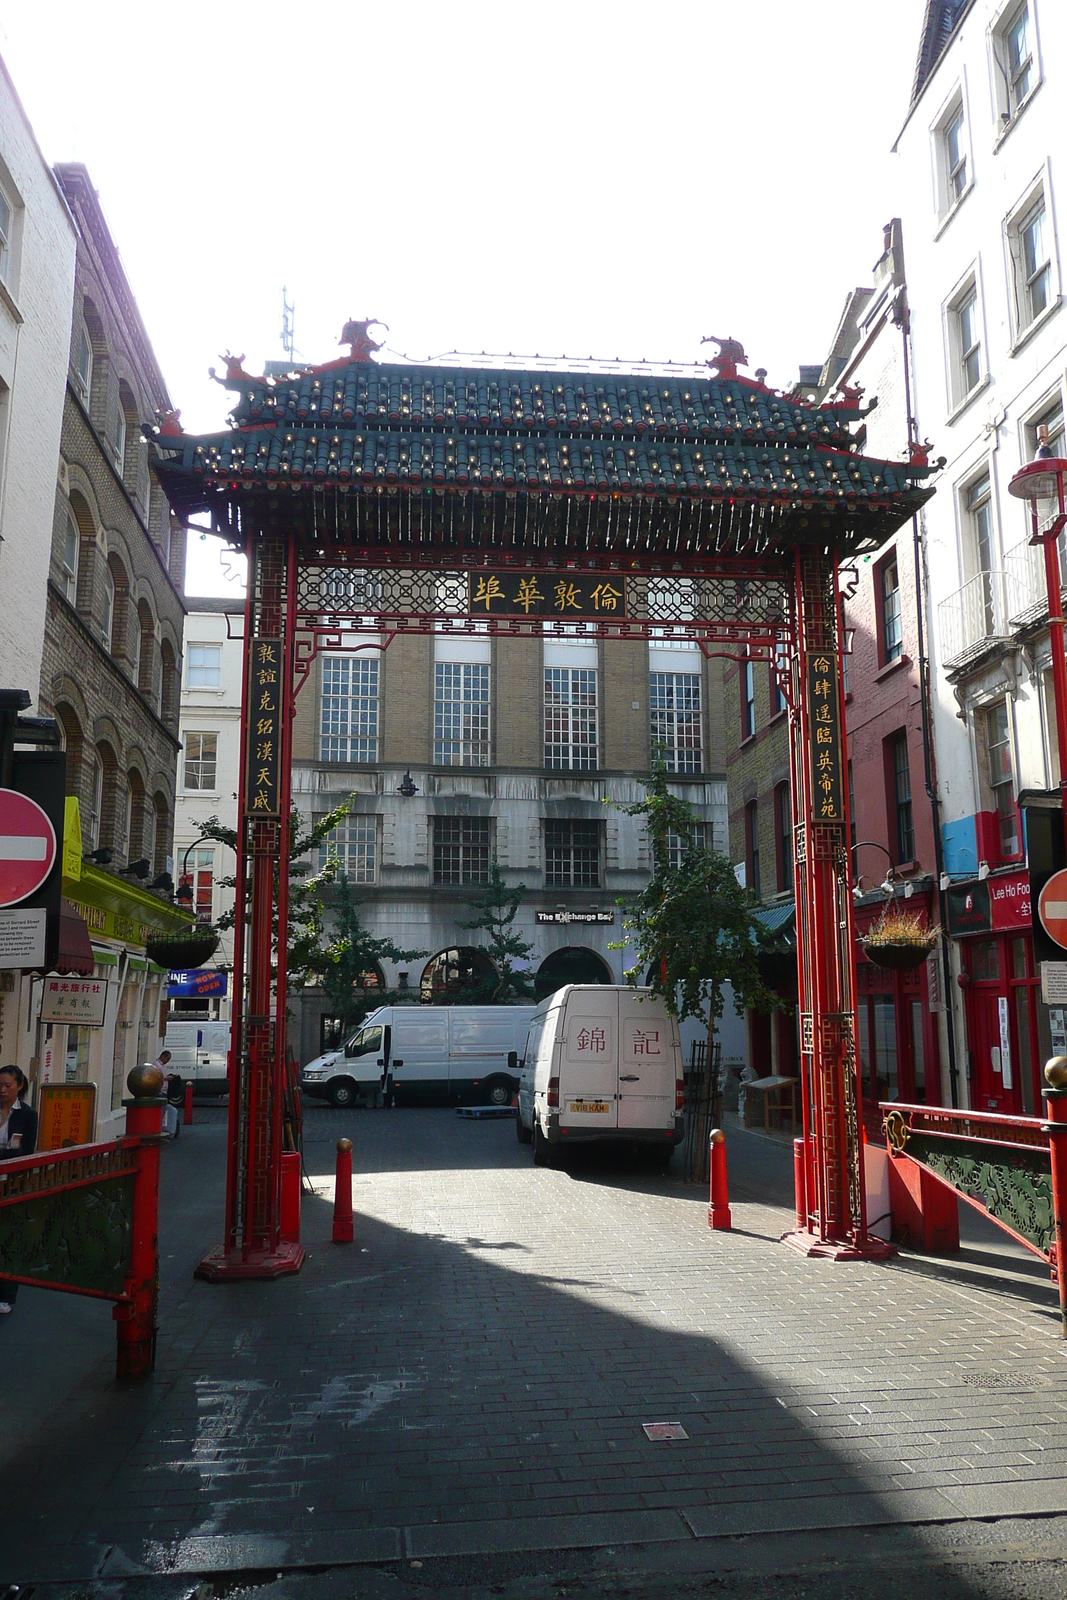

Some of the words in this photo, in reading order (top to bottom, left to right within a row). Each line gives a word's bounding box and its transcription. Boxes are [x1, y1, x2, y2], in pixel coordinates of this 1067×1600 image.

[992, 888, 1005, 900] Lee
[1005, 884, 1016, 898] Ho
[537, 913, 554, 921] The
[555, 911, 596, 923] Exchange
[195, 972, 216, 985] NOW
[50, 982, 101, 993] 陽光旅行社
[198, 980, 220, 994] OPEN
[576, 1027, 661, 1055] 錦記
